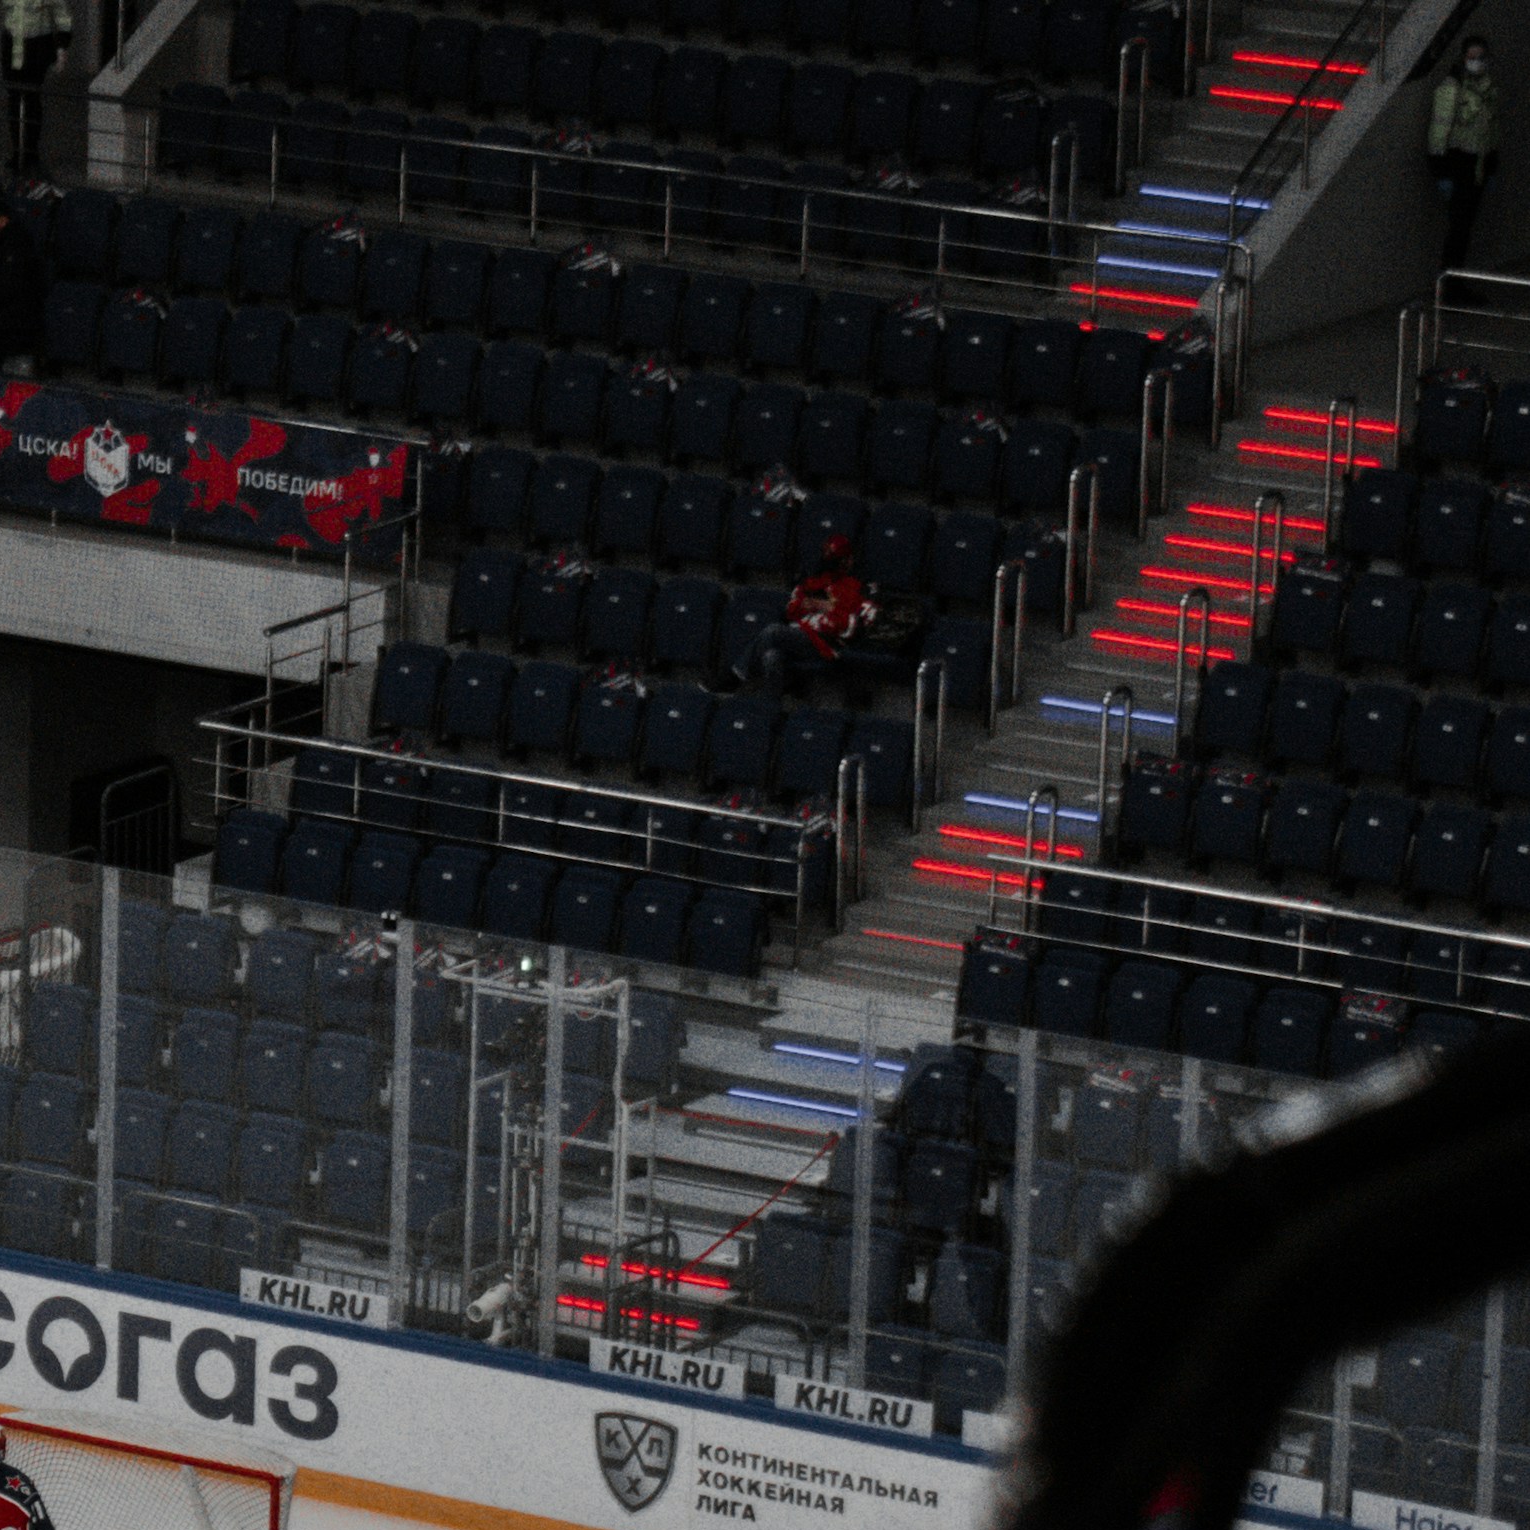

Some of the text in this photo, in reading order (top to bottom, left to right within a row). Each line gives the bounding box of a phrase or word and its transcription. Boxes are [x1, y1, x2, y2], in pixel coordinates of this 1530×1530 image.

[19, 434, 79, 459] ЦСКА!
[137, 453, 173, 476] МЫ
[237, 466, 344, 502] ПОБЕДИМ!
[258, 1274, 371, 1322] KHL.RU
[607, 1343, 726, 1392] KHL.RU
[793, 1381, 915, 1431] KHL.RU
[697, 1442, 940, 1510] КОНТИНЕНТАЛЬНАЯ
[697, 1468, 846, 1516] ХОККЕЙНАЯ
[695, 1493, 757, 1523] ЛИГА
